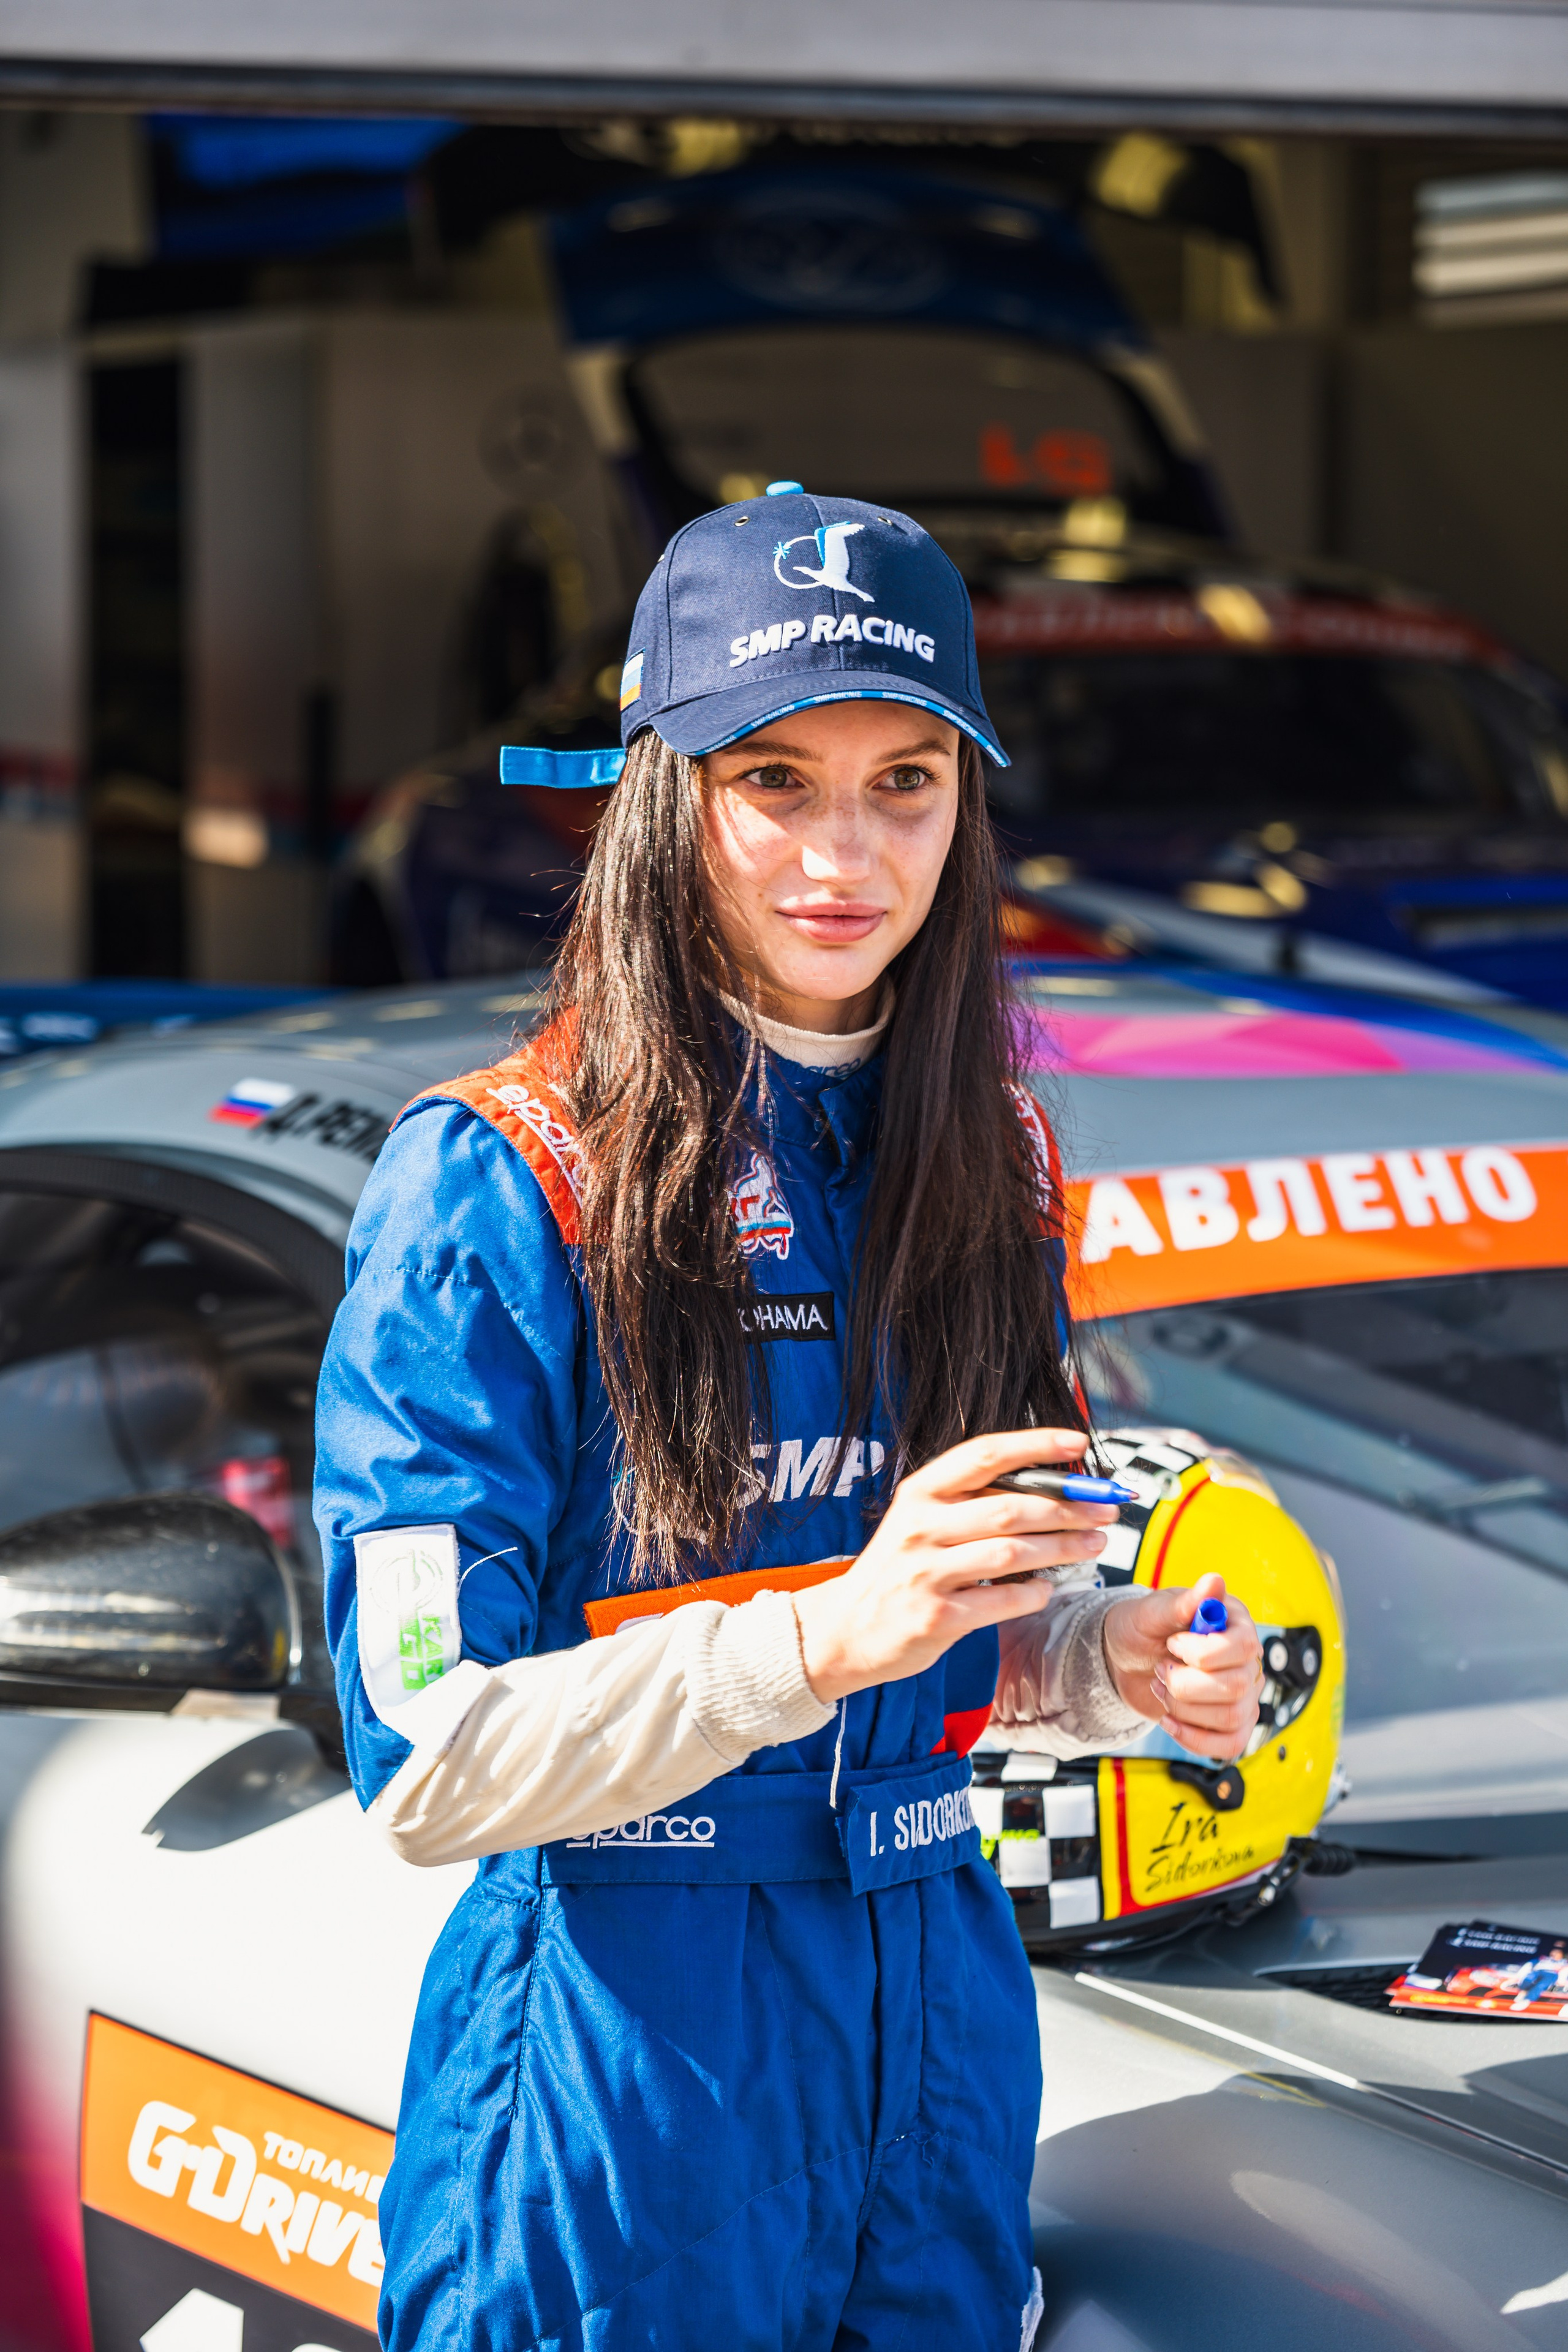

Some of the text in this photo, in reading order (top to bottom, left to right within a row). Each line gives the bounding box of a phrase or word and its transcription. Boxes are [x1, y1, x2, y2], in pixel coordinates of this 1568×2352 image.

[729, 619, 806, 668] SMP
[810, 614, 935, 663] RACING
[1083, 1145, 1538, 1264] АВЛЕНО
[421, 1615, 445, 1684] KAR
[1151, 1802, 1217, 1853] Ira
